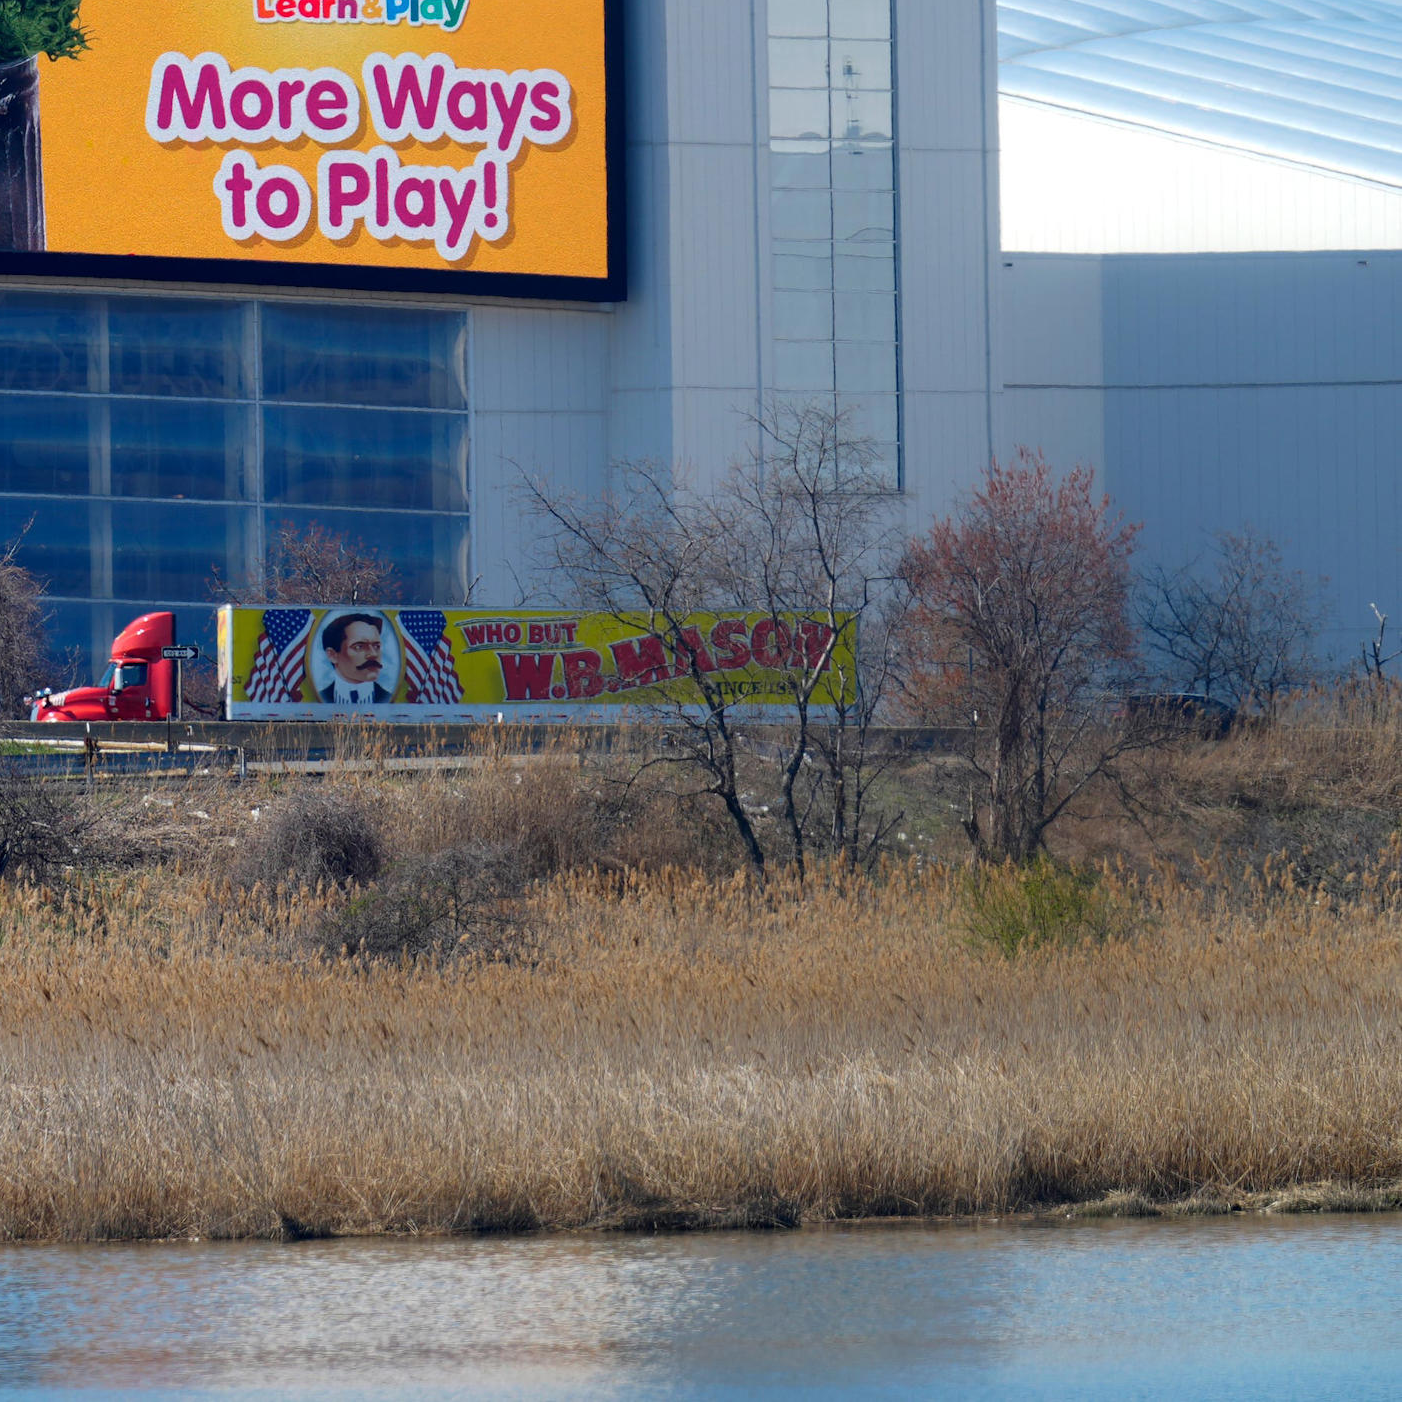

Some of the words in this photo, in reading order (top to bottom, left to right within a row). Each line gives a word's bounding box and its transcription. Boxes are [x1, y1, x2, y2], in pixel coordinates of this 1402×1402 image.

[156, 63, 349, 131] More
[372, 63, 562, 151] Ways
[224, 162, 301, 229] to
[328, 157, 499, 249] Play!
[461, 622, 522, 647] WHO
[527, 620, 578, 645] BUT
